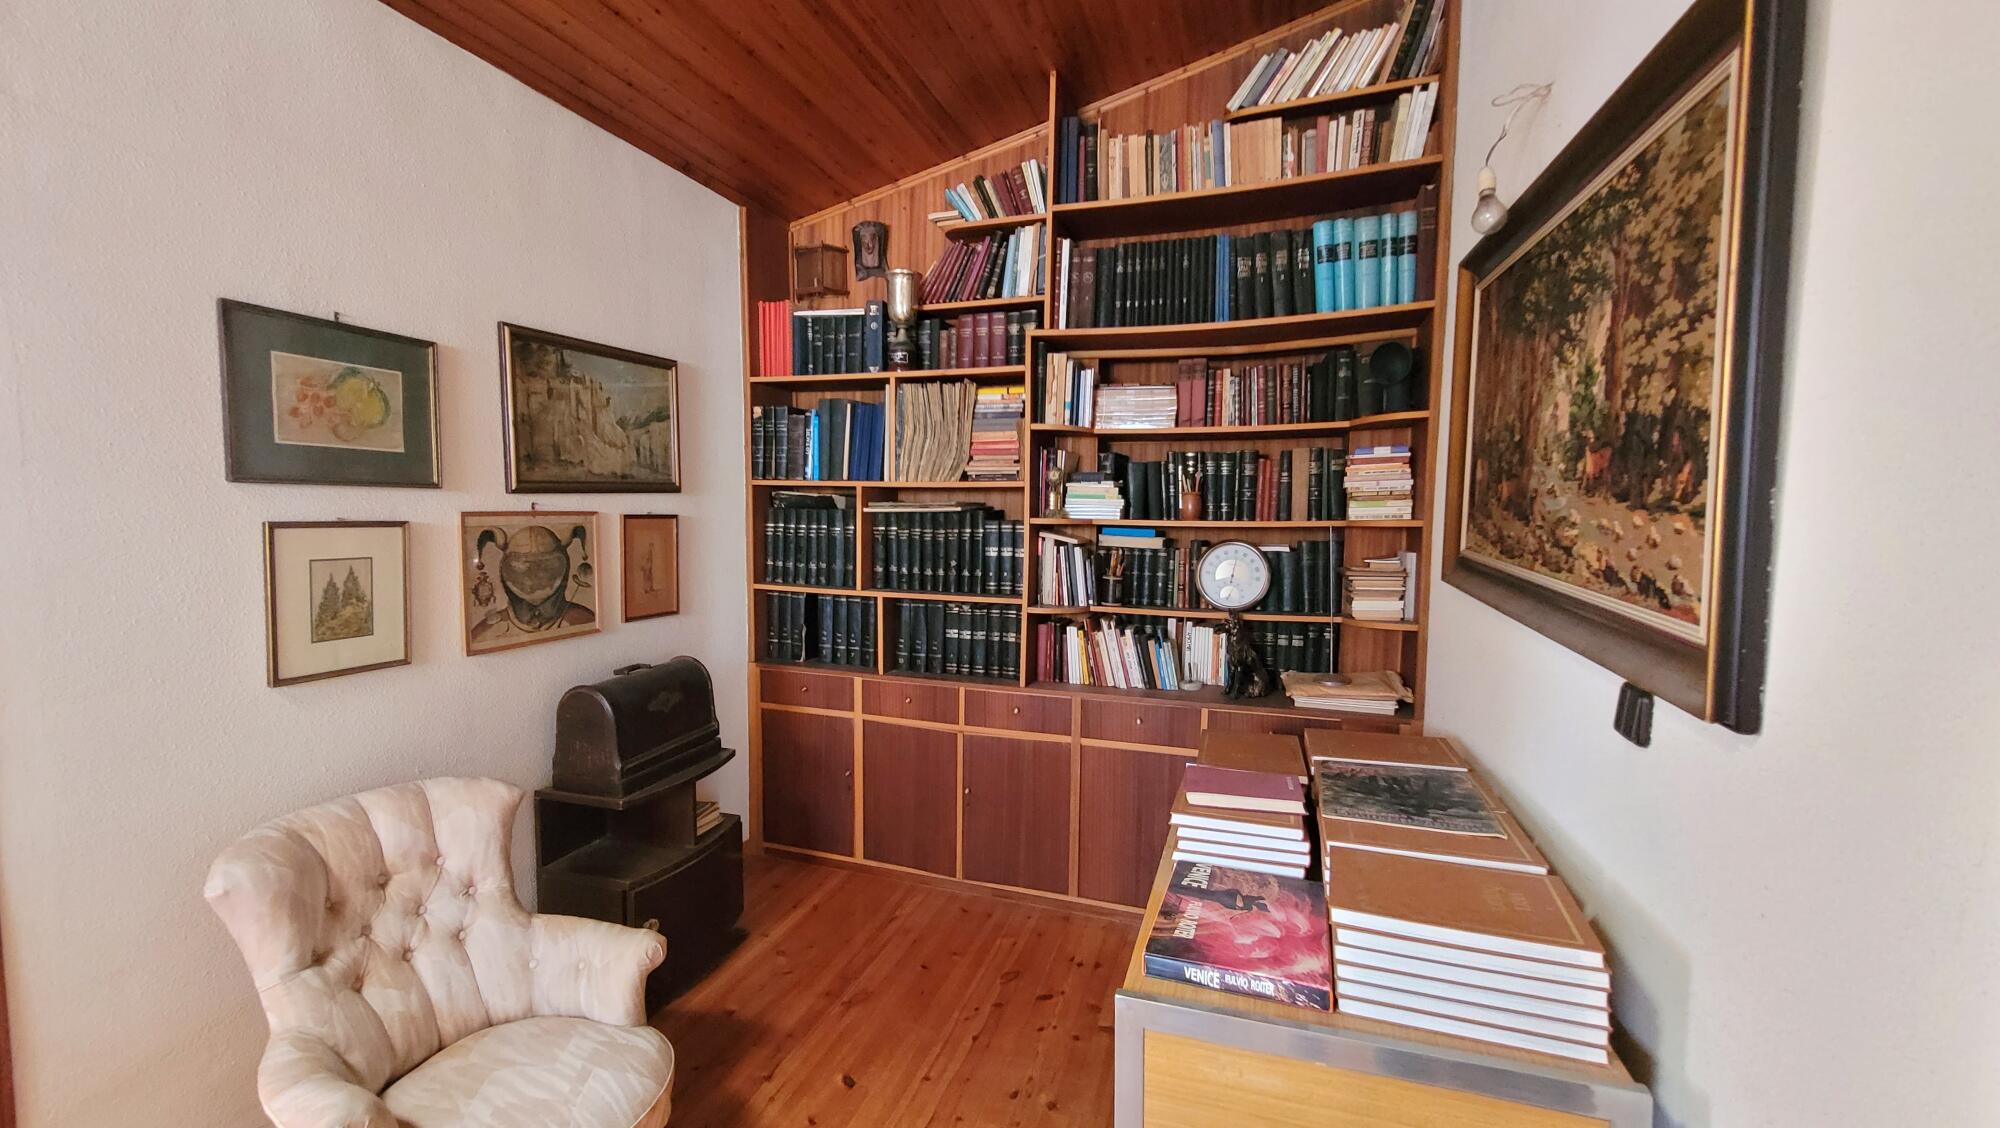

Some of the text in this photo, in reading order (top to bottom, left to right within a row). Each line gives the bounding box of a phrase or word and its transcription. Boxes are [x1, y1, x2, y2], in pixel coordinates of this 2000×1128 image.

[1181, 863, 1212, 889] VENICE
[1184, 966, 1275, 996] VENICE FULVIO ROITER
